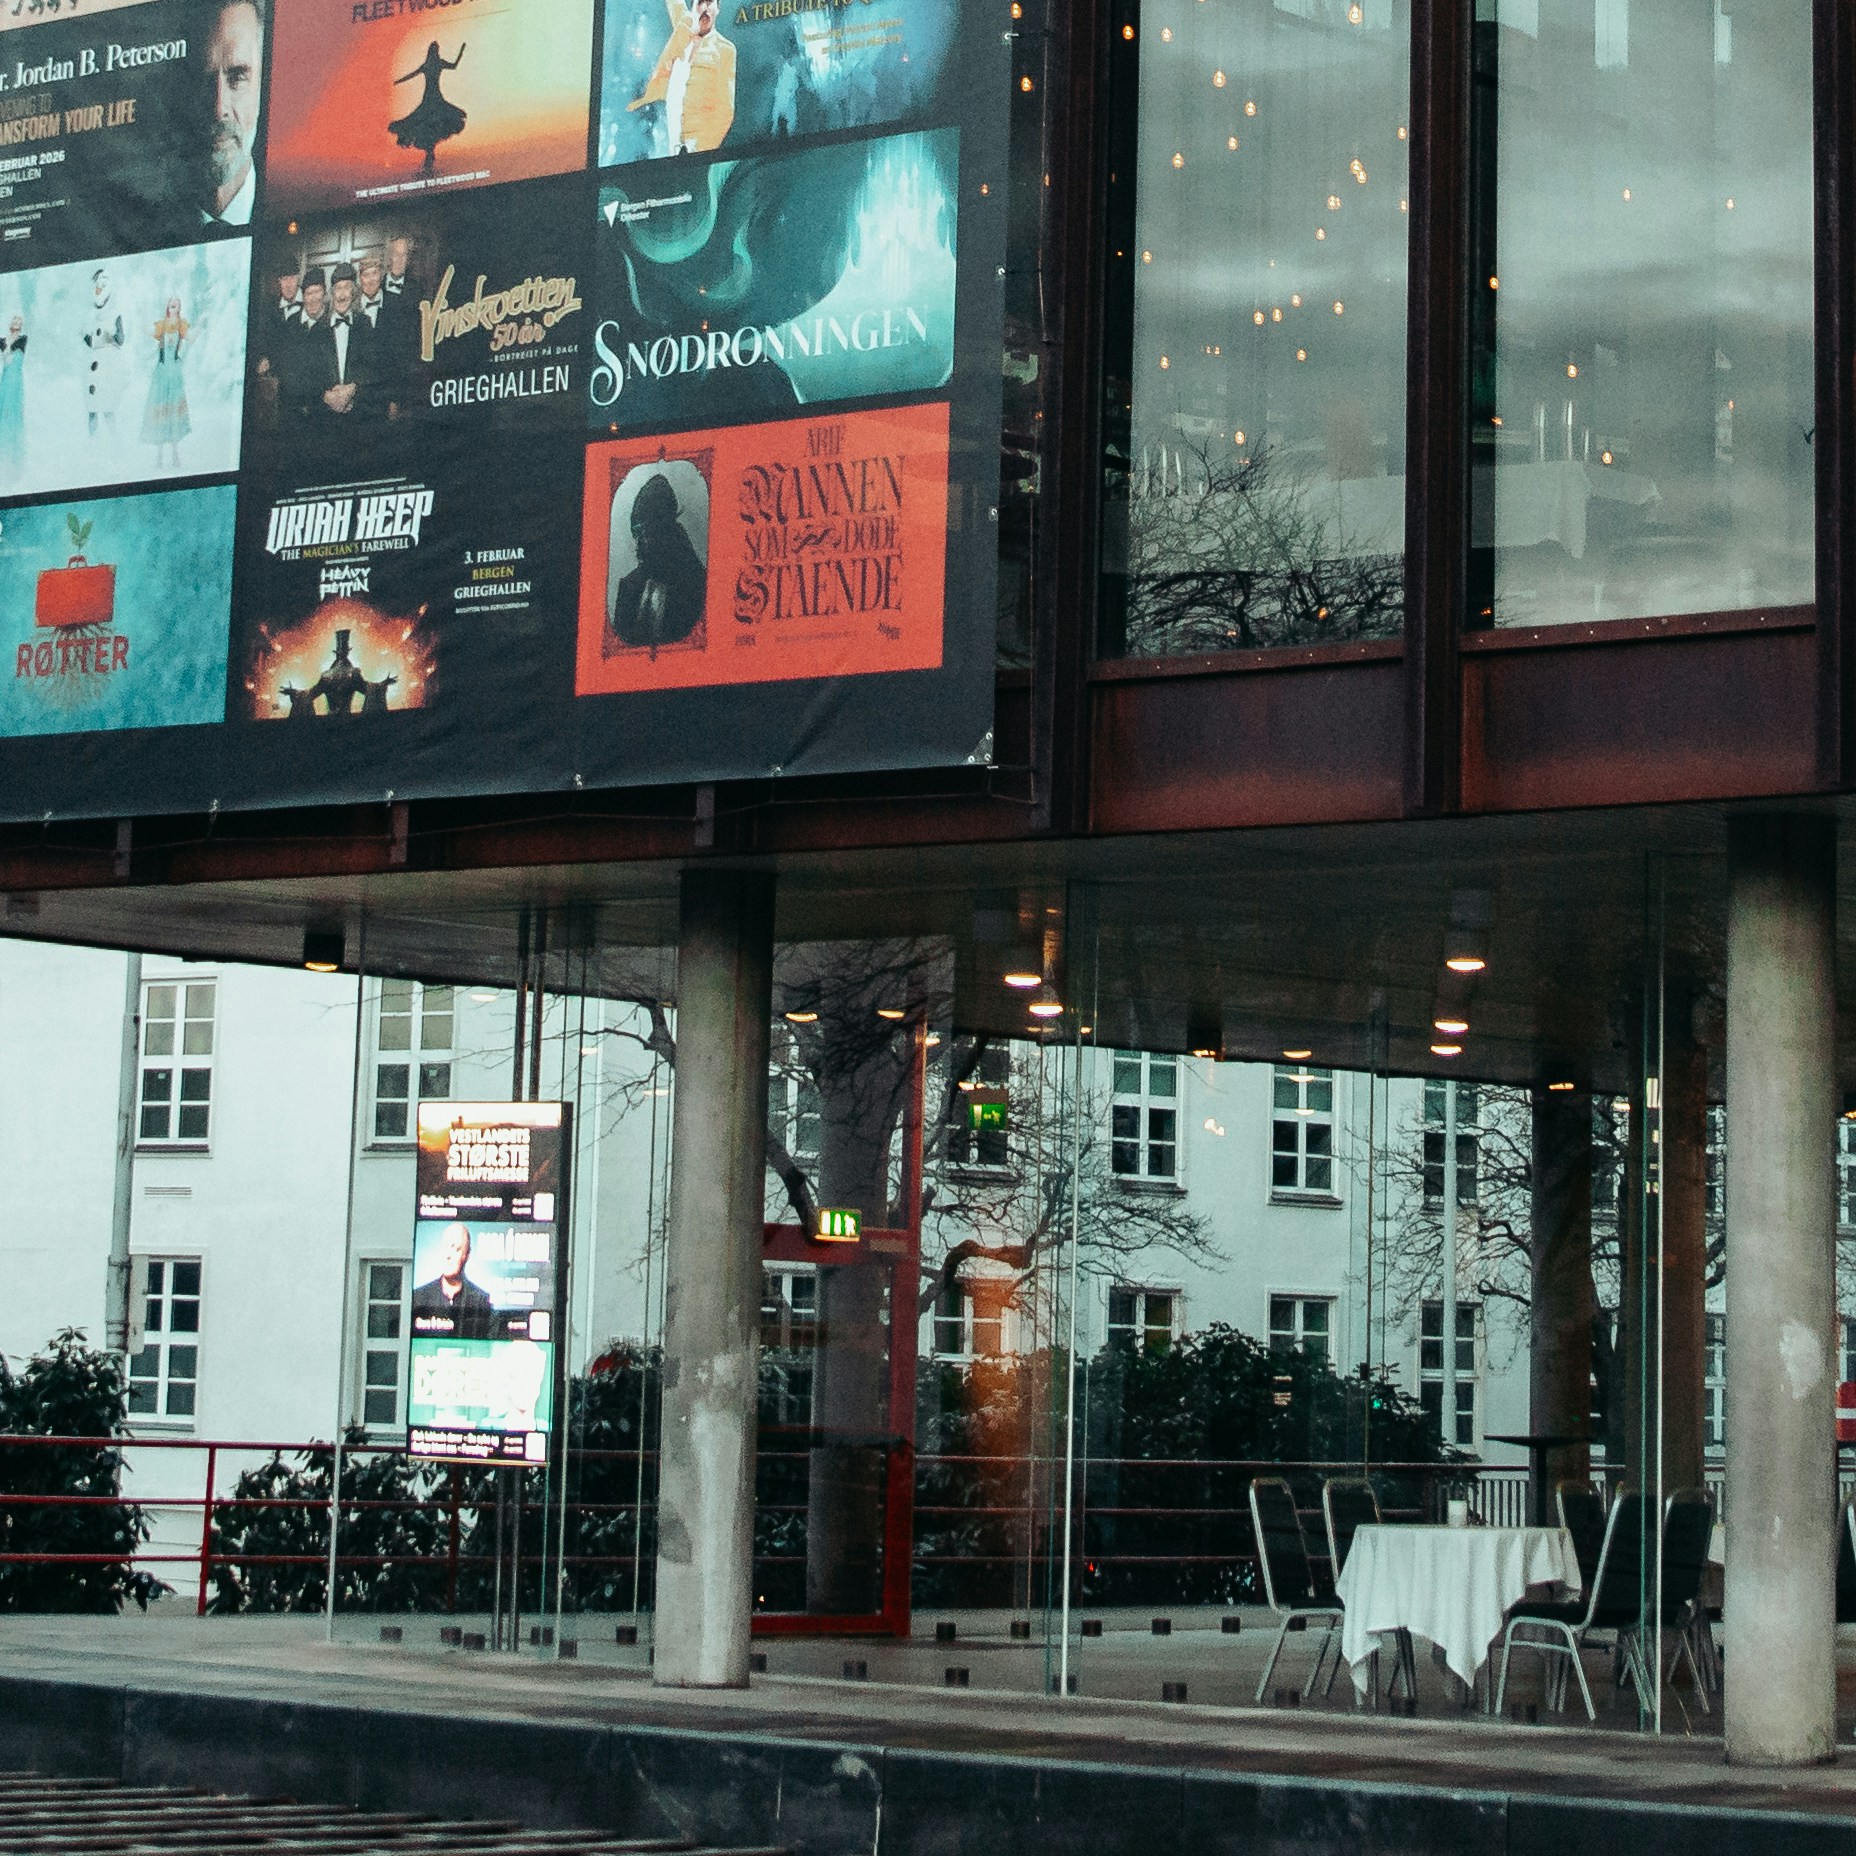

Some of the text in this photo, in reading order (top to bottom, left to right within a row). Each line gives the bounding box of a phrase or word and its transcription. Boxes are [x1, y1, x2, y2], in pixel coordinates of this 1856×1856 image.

[735, 8, 748, 25] A
[14, 56, 74, 89] Jordan
[79, 49, 100, 75] B.
[105, 38, 187, 72] Peterson
[64, 104, 105, 134] YOUR
[107, 98, 137, 127] LIFE
[39, 150, 66, 166] 2026
[490, 321, 518, 351] 50
[590, 304, 929, 406] SNØDRONNINGEN
[430, 364, 569, 407] GRIEGHALLEN
[265, 490, 435, 555] URIAH HEEP
[281, 547, 301, 561] THE
[302, 542, 359, 560] MAGICIAN'S
[361, 538, 409, 553] FAREWELL
[464, 547, 525, 565] 3. FEBRUAR
[320, 565, 372, 583] HEAVY
[471, 565, 515, 581] BERGEN
[453, 581, 532, 600] GRIEGHALLEN
[15, 635, 131, 679] RØTTER
[447, 1144, 530, 1167] STØRSTE
